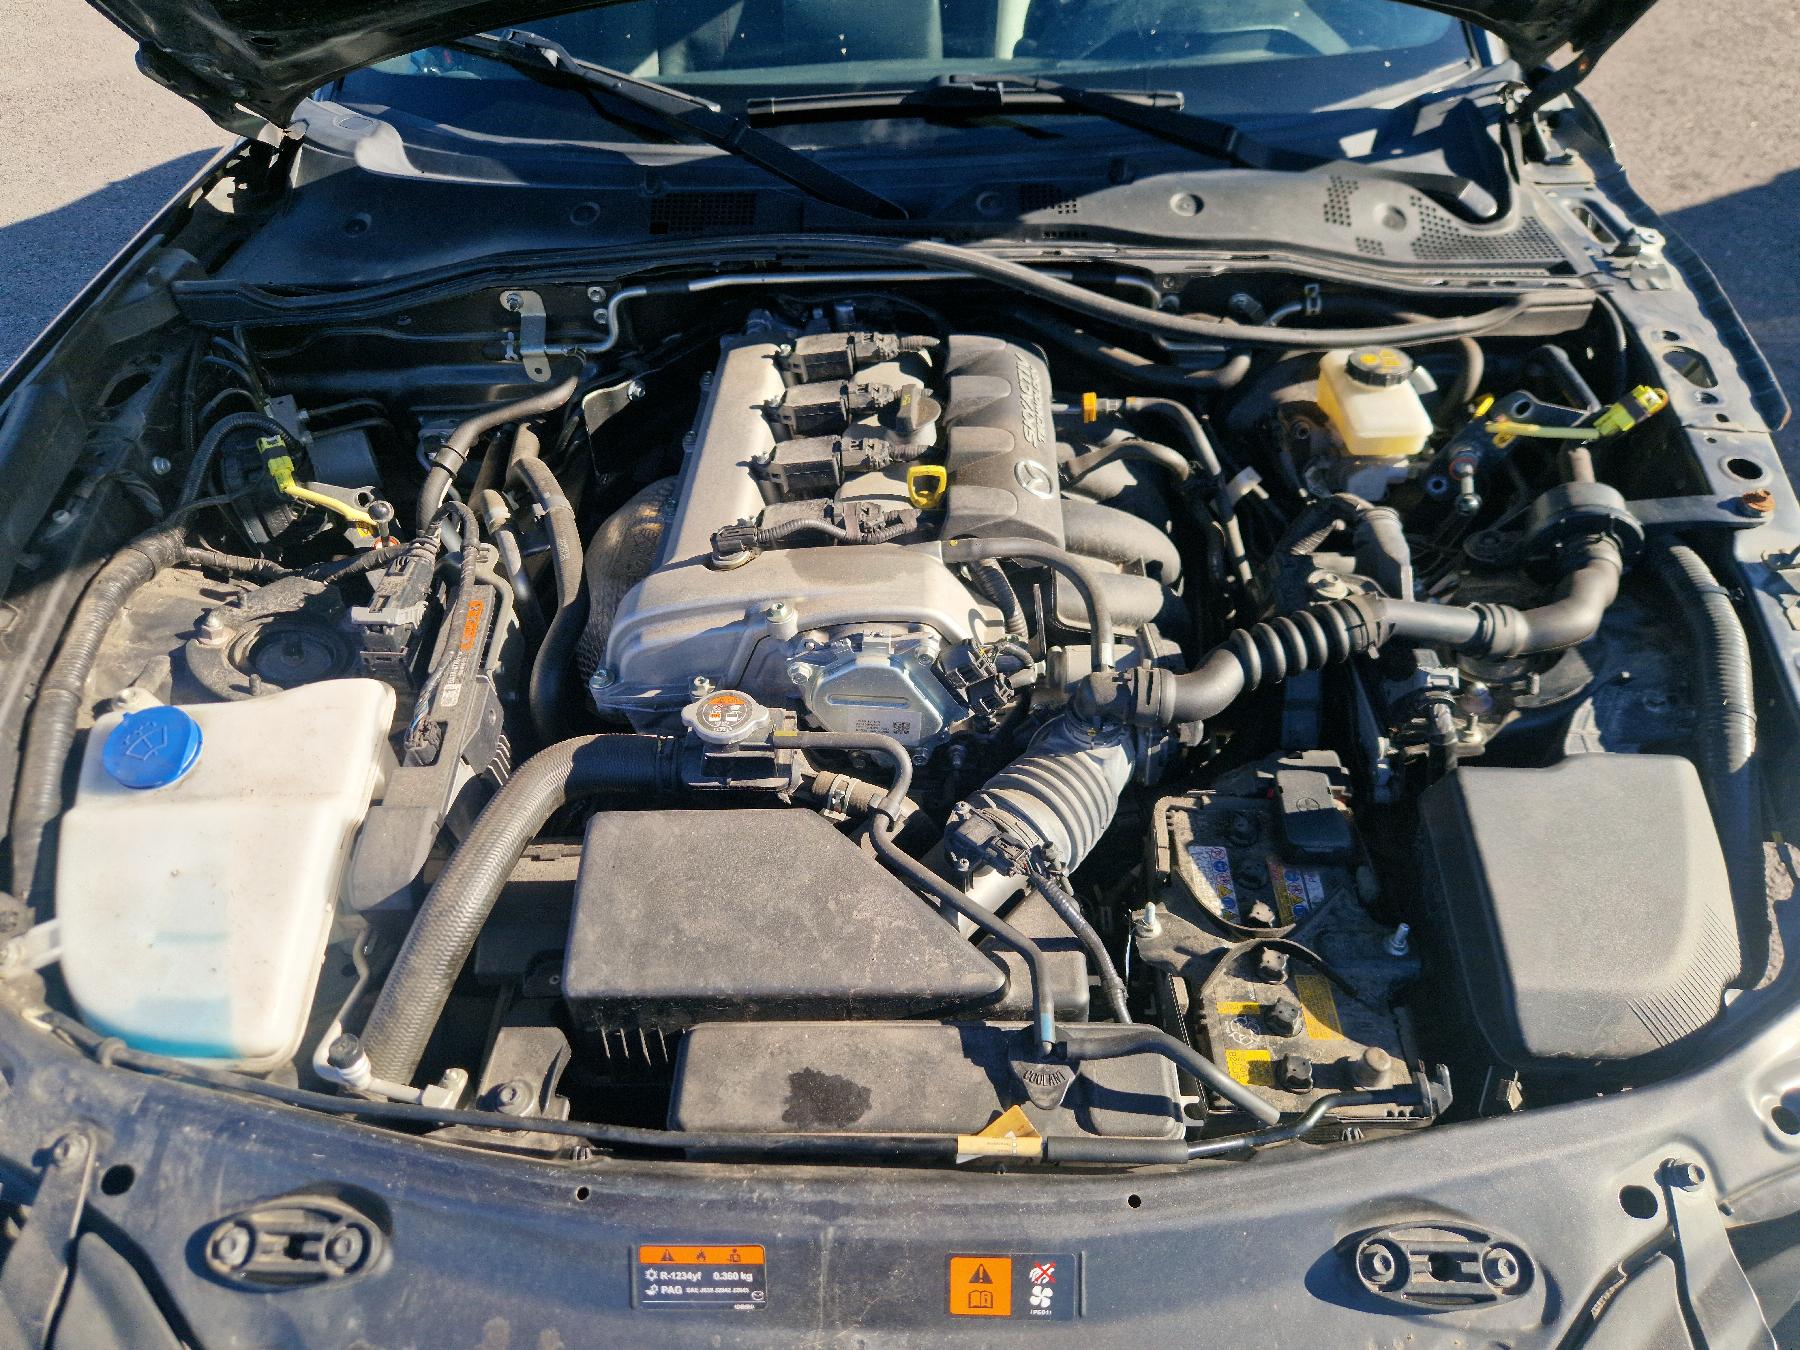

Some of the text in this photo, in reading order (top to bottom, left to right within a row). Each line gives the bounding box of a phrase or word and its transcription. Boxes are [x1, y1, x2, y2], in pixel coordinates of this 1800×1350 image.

[1014, 352, 1038, 448] SKYACTIV
[1022, 1069, 1066, 1086] COOLANT
[660, 1271, 702, 1282] R-1234yf
[740, 1271, 753, 1282] kg
[661, 1285, 683, 1294] PAG
